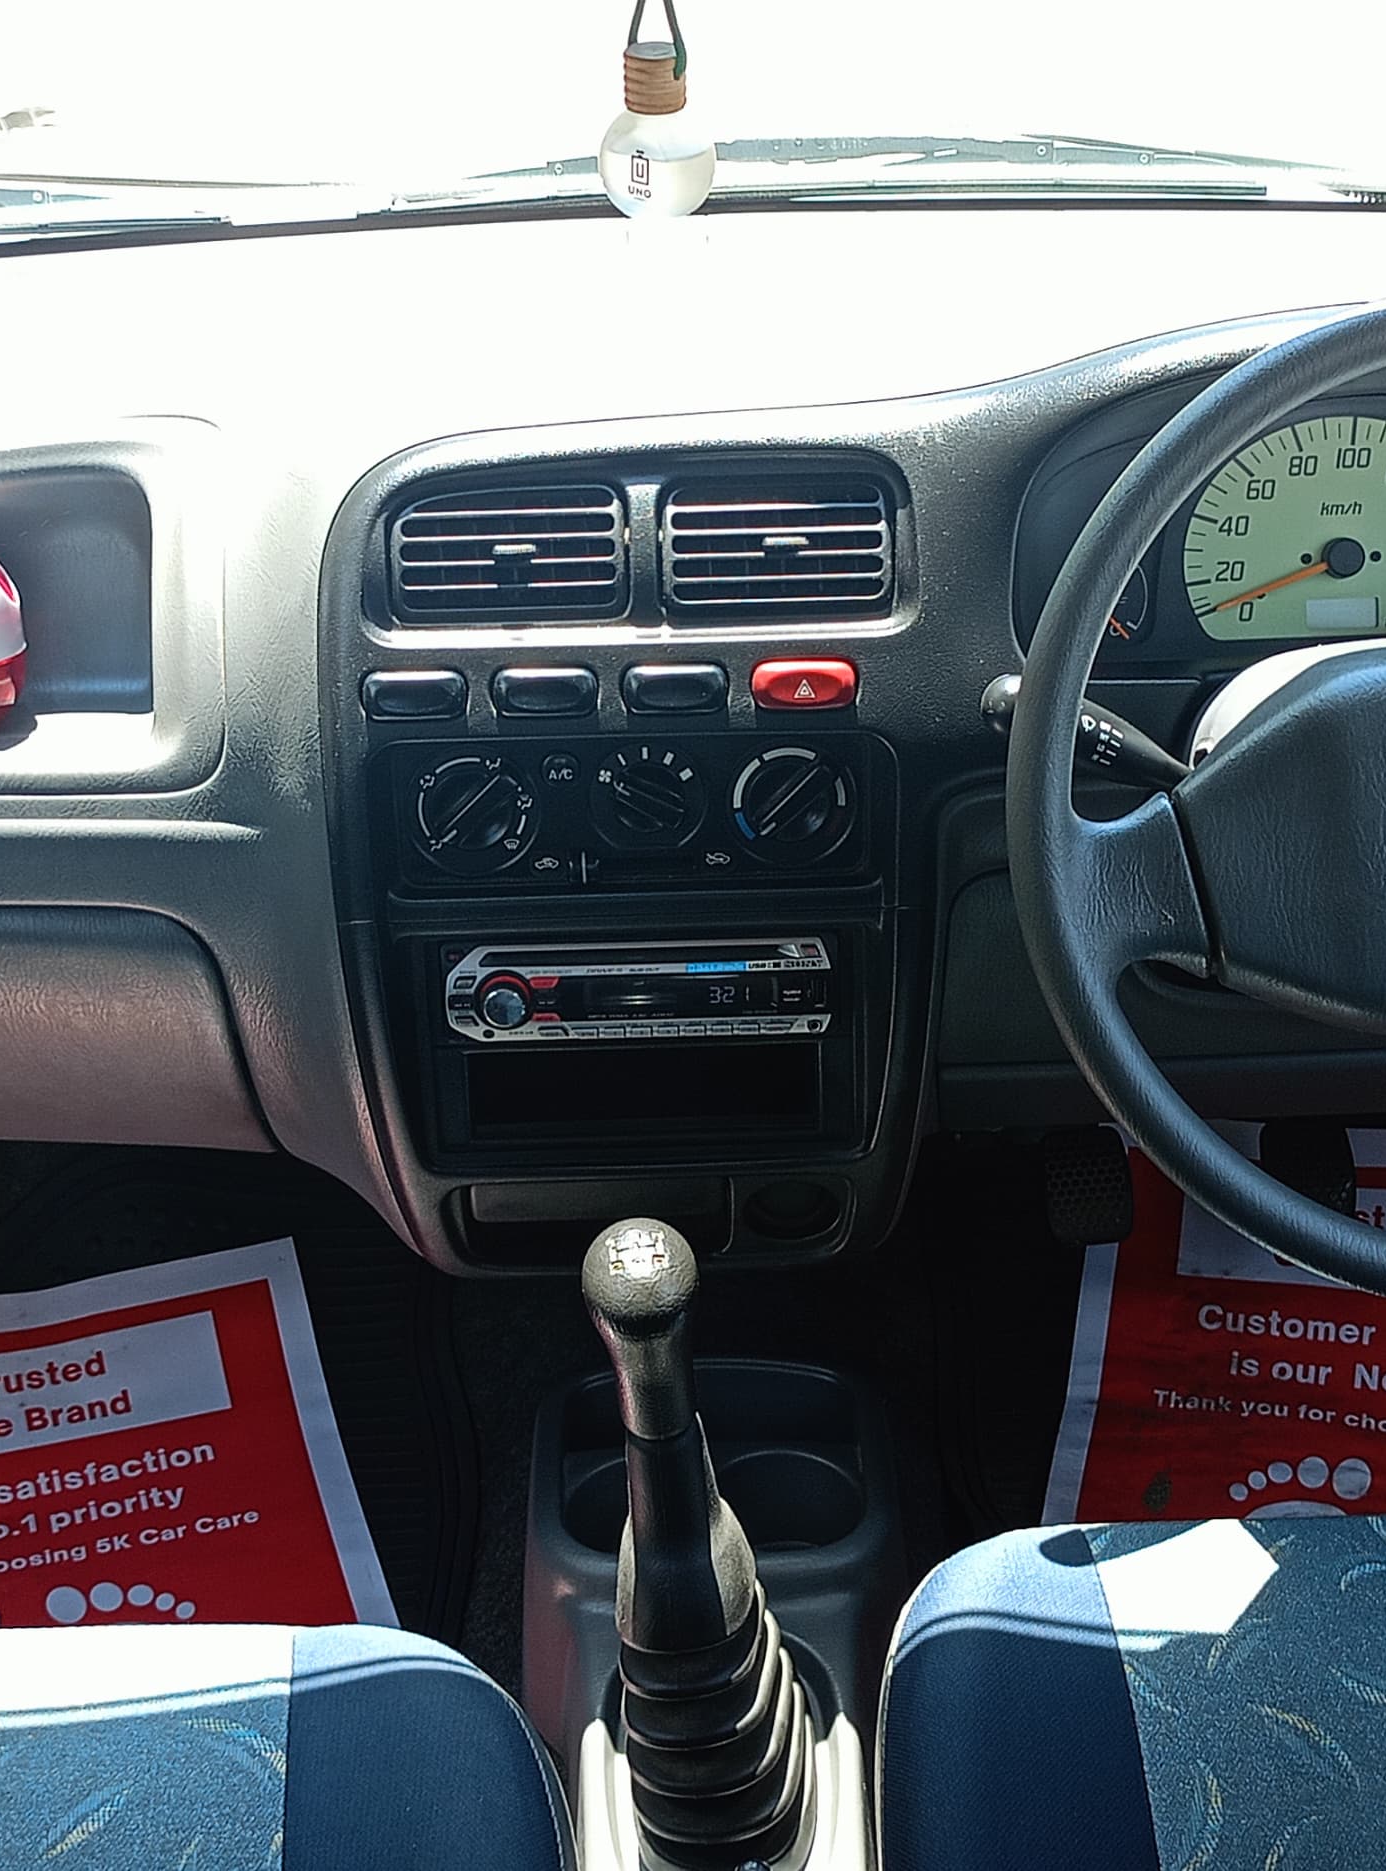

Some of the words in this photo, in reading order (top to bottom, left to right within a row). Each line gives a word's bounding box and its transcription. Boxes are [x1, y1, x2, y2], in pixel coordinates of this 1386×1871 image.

[628, 185, 651, 198] UNO
[1289, 456, 1317, 476] 80
[1336, 448, 1371, 469] 100
[1246, 479, 1276, 500] 60
[1320, 502, 1362, 516] km/h
[1218, 515, 1249, 536] 40
[1215, 561, 1244, 581] 20
[1239, 602, 1253, 622] 0
[548, 768, 573, 780] A/C
[1356, 1205, 1385, 1230] st
[1198, 1304, 1376, 1345] Customer
[1230, 1351, 1259, 1377] is
[1272, 1361, 1331, 1385] our
[25, 1389, 132, 1432] Brand
[1153, 1390, 1231, 1412] Thank
[1241, 1401, 1289, 1417] you
[1298, 1404, 1336, 1423] for
[51, 1486, 184, 1533] priority
[96, 1535, 131, 1554] 5K
[139, 1525, 186, 1545] Car
[196, 1510, 260, 1534] Care
